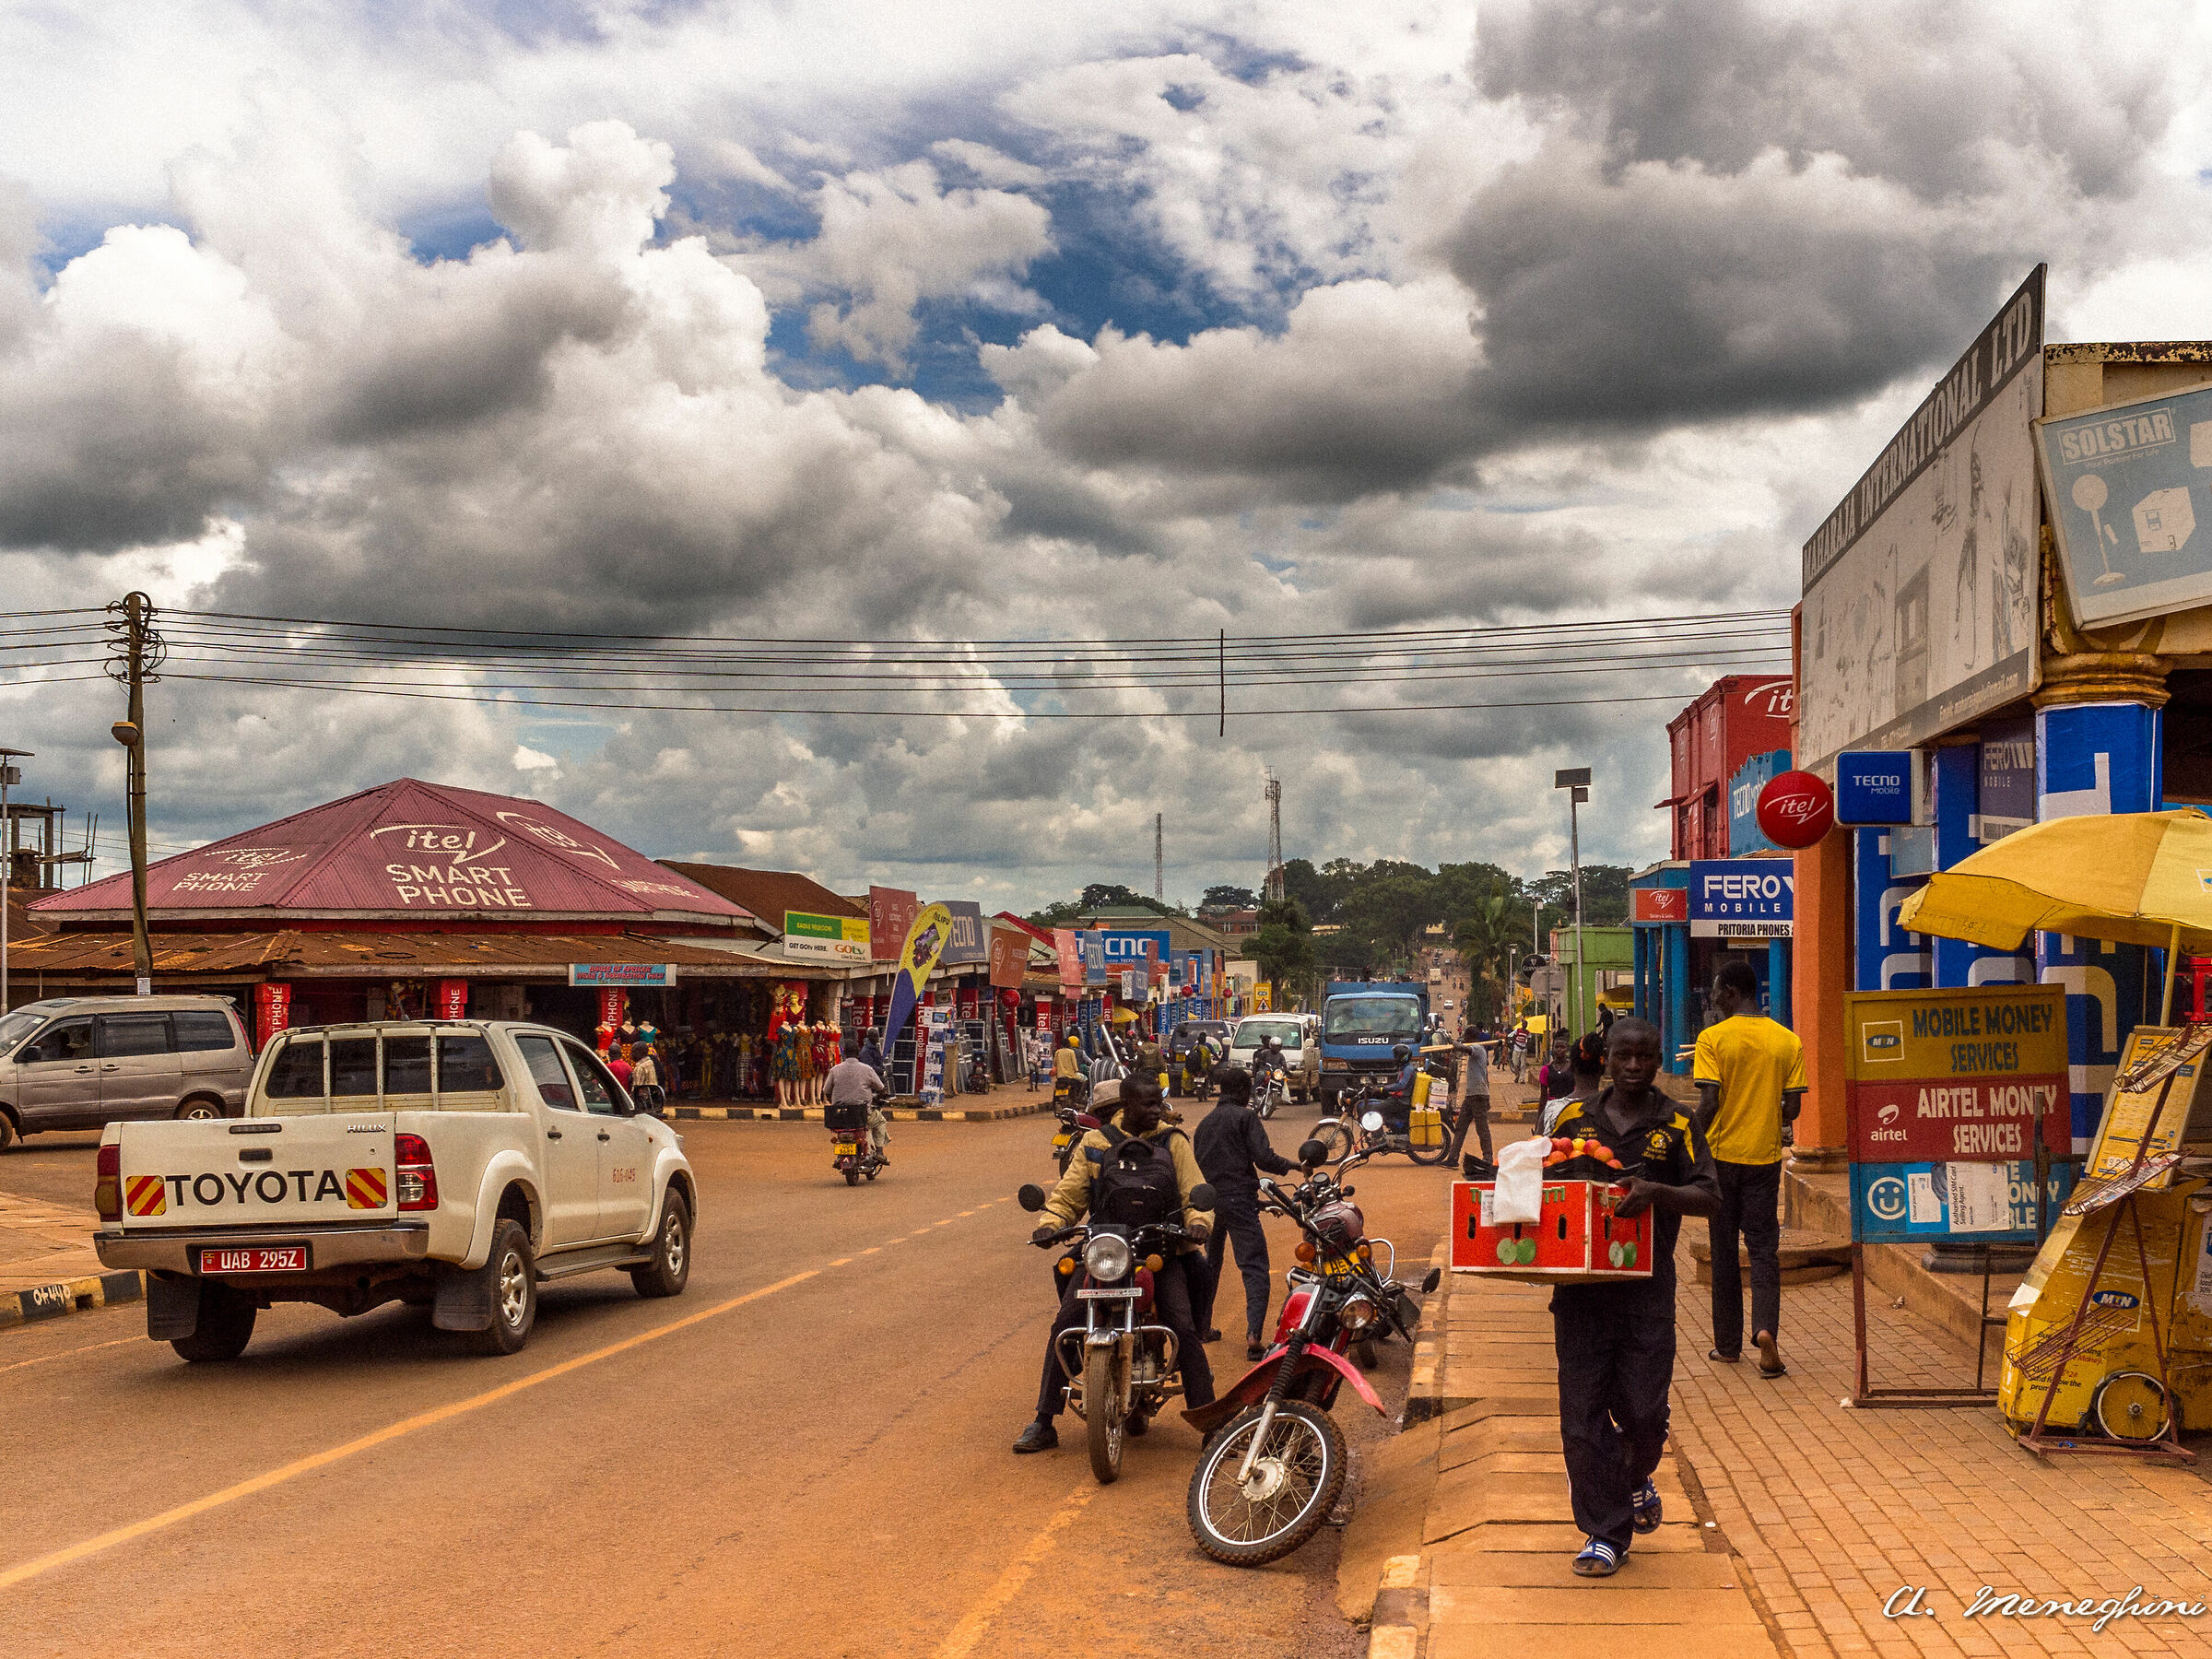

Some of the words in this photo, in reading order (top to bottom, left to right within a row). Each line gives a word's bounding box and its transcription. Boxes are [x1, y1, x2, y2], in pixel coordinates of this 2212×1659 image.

[1804, 494, 1856, 589] MAHARAJA
[1861, 348, 1982, 526] INTERNATIONAL
[1991, 292, 2031, 388] LTD
[2063, 414, 2171, 460] SOLSTAR
[1768, 689, 1794, 712] it
[1853, 775, 1900, 786] TECNO
[1983, 776, 2010, 788] MOBILE
[1780, 796, 1816, 815] itel
[406, 830, 476, 850] itel
[182, 872, 270, 883] SMART
[385, 864, 511, 886] SMART
[171, 882, 260, 892] PHONE
[396, 885, 532, 908] PHONE
[1654, 891, 1670, 902] itel
[1704, 903, 1781, 912] MOBILE
[949, 915, 976, 948] TECNO
[1718, 924, 1756, 935] PRITORIA
[1757, 925, 1790, 936] PHONES
[834, 944, 865, 955] GOtv
[1075, 938, 1153, 956] TCNO
[450, 989, 460, 1020] HONE
[962, 1002, 973, 1018] ite
[1038, 1013, 1049, 1030] itel
[1913, 1007, 1982, 1038] MOBILE
[1986, 1004, 2053, 1035] MONEY
[1872, 1036, 1894, 1047] MTN
[1951, 1041, 2018, 1072] SERVICES
[1917, 1087, 1984, 1119] AIRTEL
[347, 1124, 387, 1134] HILUX
[1871, 1128, 1908, 1142] airtel
[1953, 1124, 2022, 1154] SERVICES
[165, 1170, 347, 1206] TOYOTA
[1951, 1192, 1959, 1226] Authorised
[221, 1252, 251, 1269] UAB
[259, 1250, 298, 1268] 295Z
[2100, 1294, 2133, 1308] MTN
[2070, 1380, 2081, 1388] the
